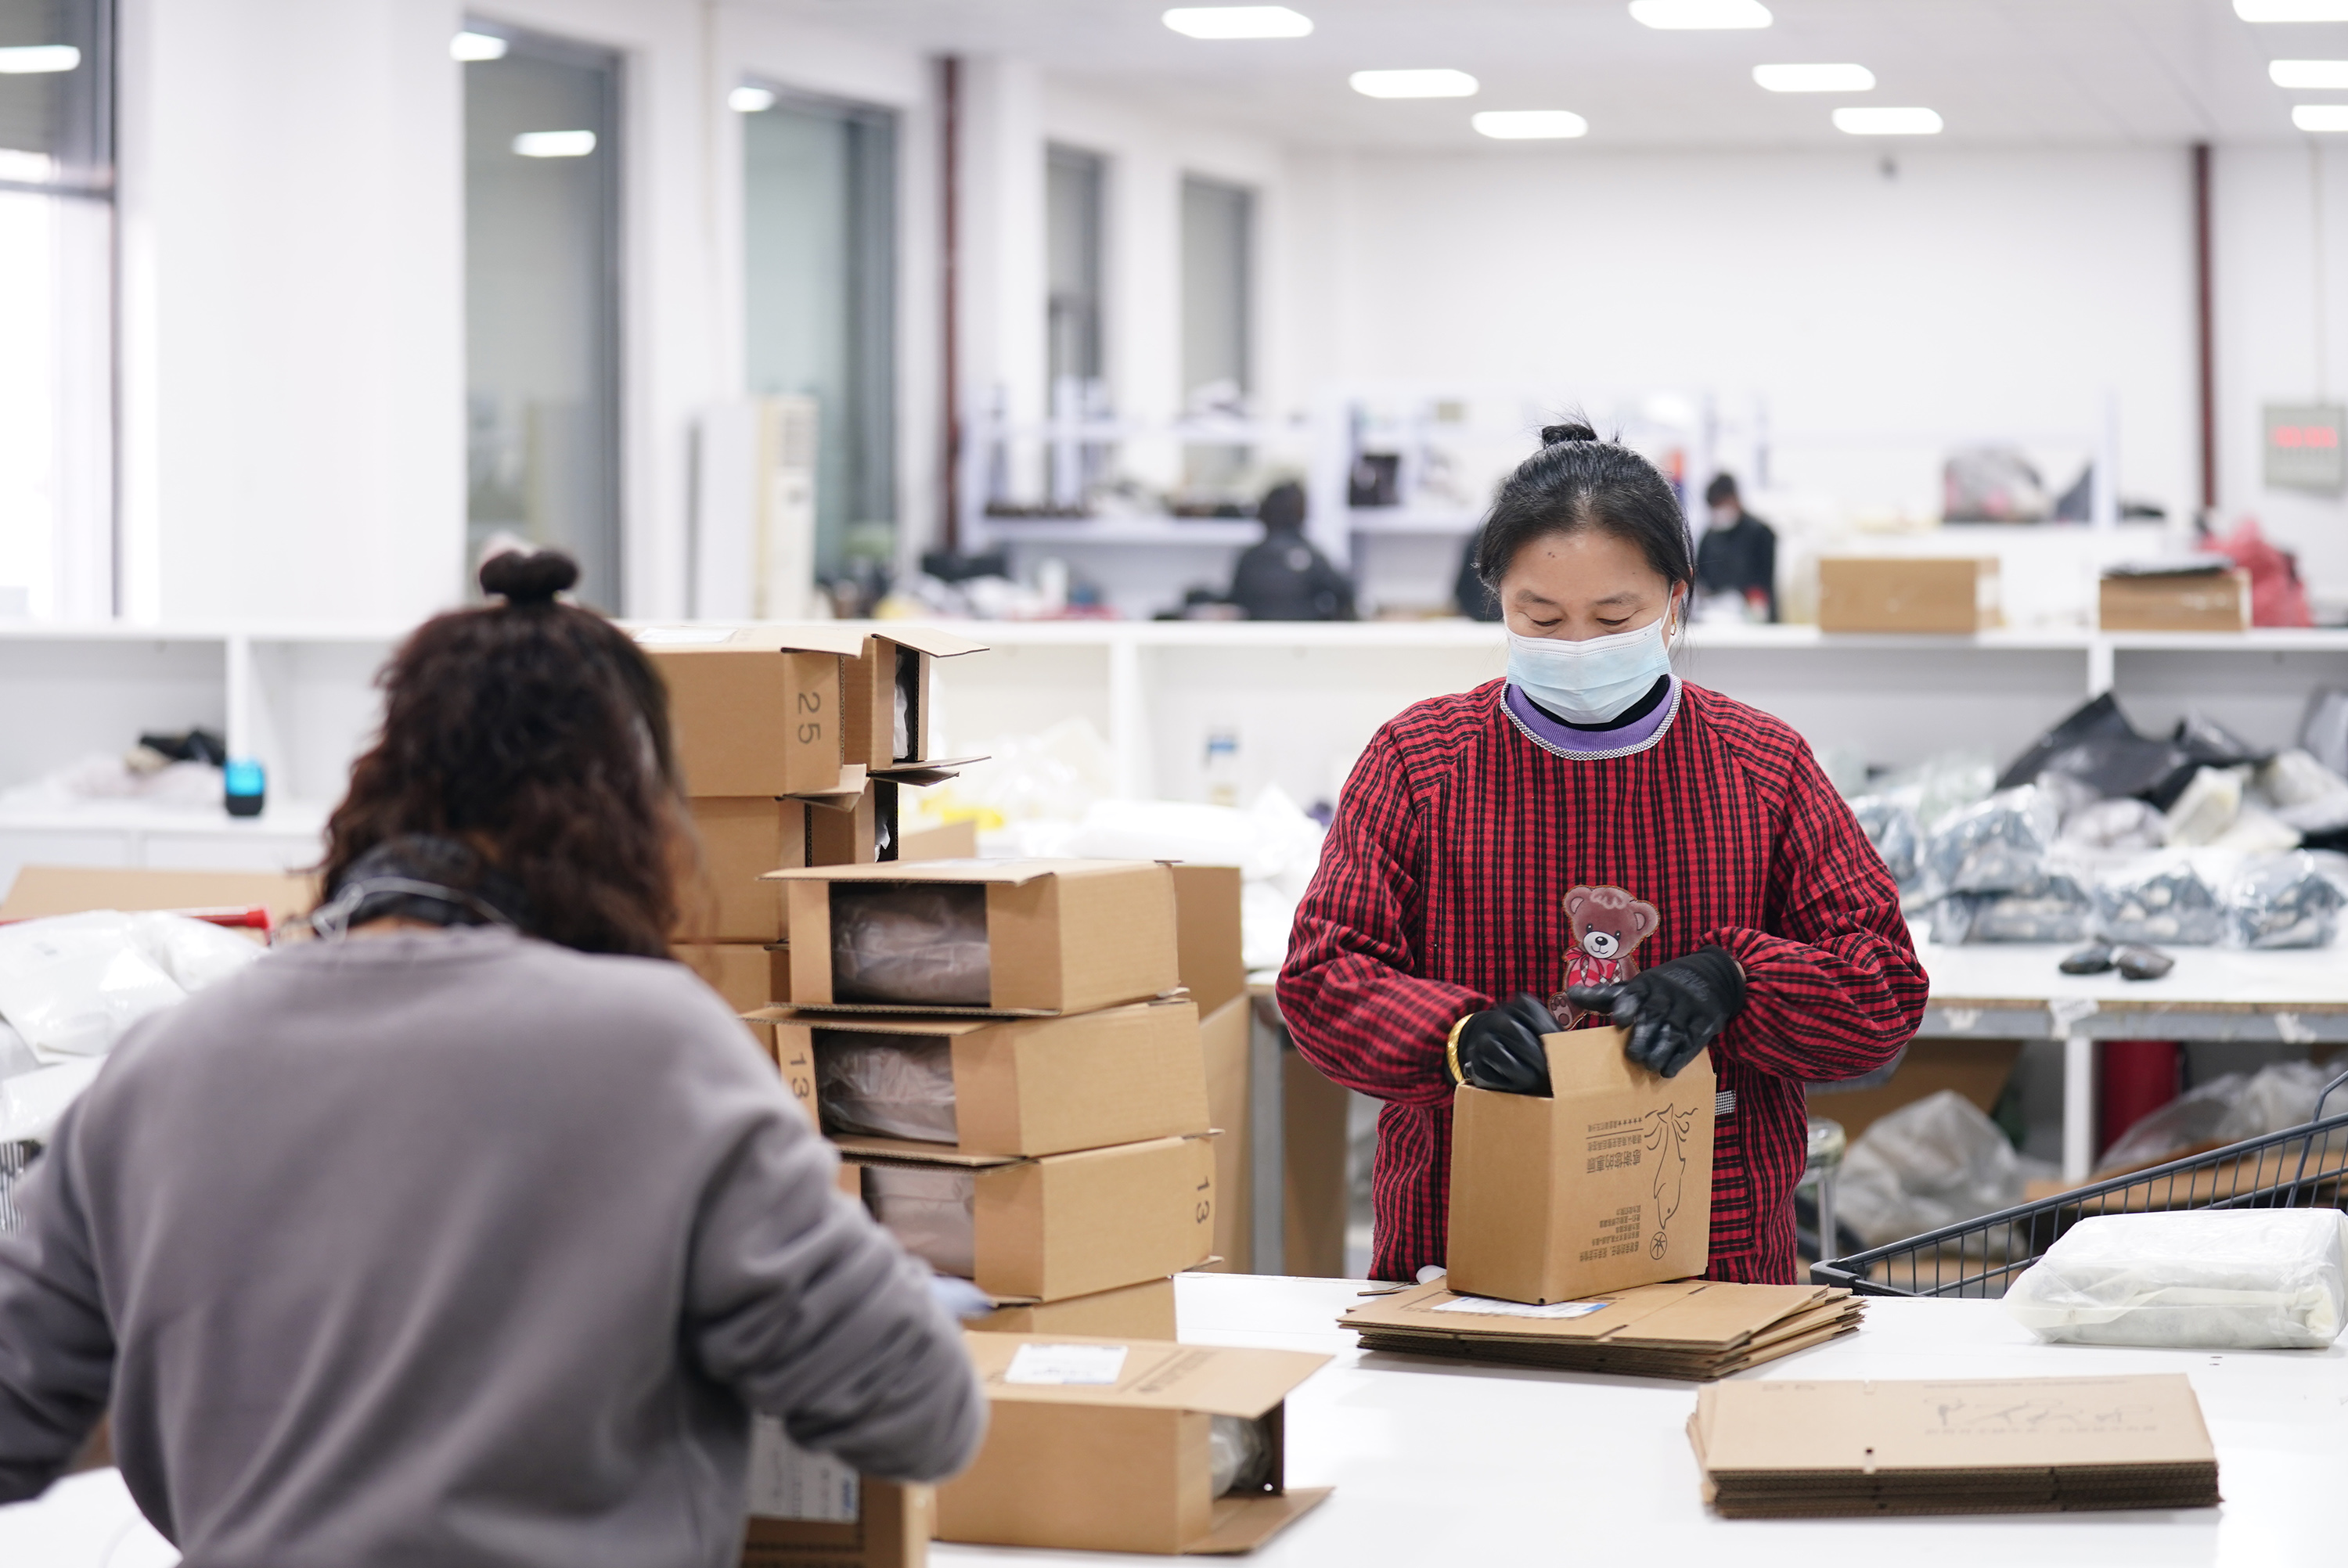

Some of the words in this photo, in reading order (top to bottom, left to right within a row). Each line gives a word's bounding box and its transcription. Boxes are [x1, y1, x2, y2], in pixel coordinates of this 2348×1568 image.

[798, 692, 820, 744] 25
[1586, 1149, 1641, 1173] 感谢您的惠顾
[1194, 1174, 1210, 1225] 13
